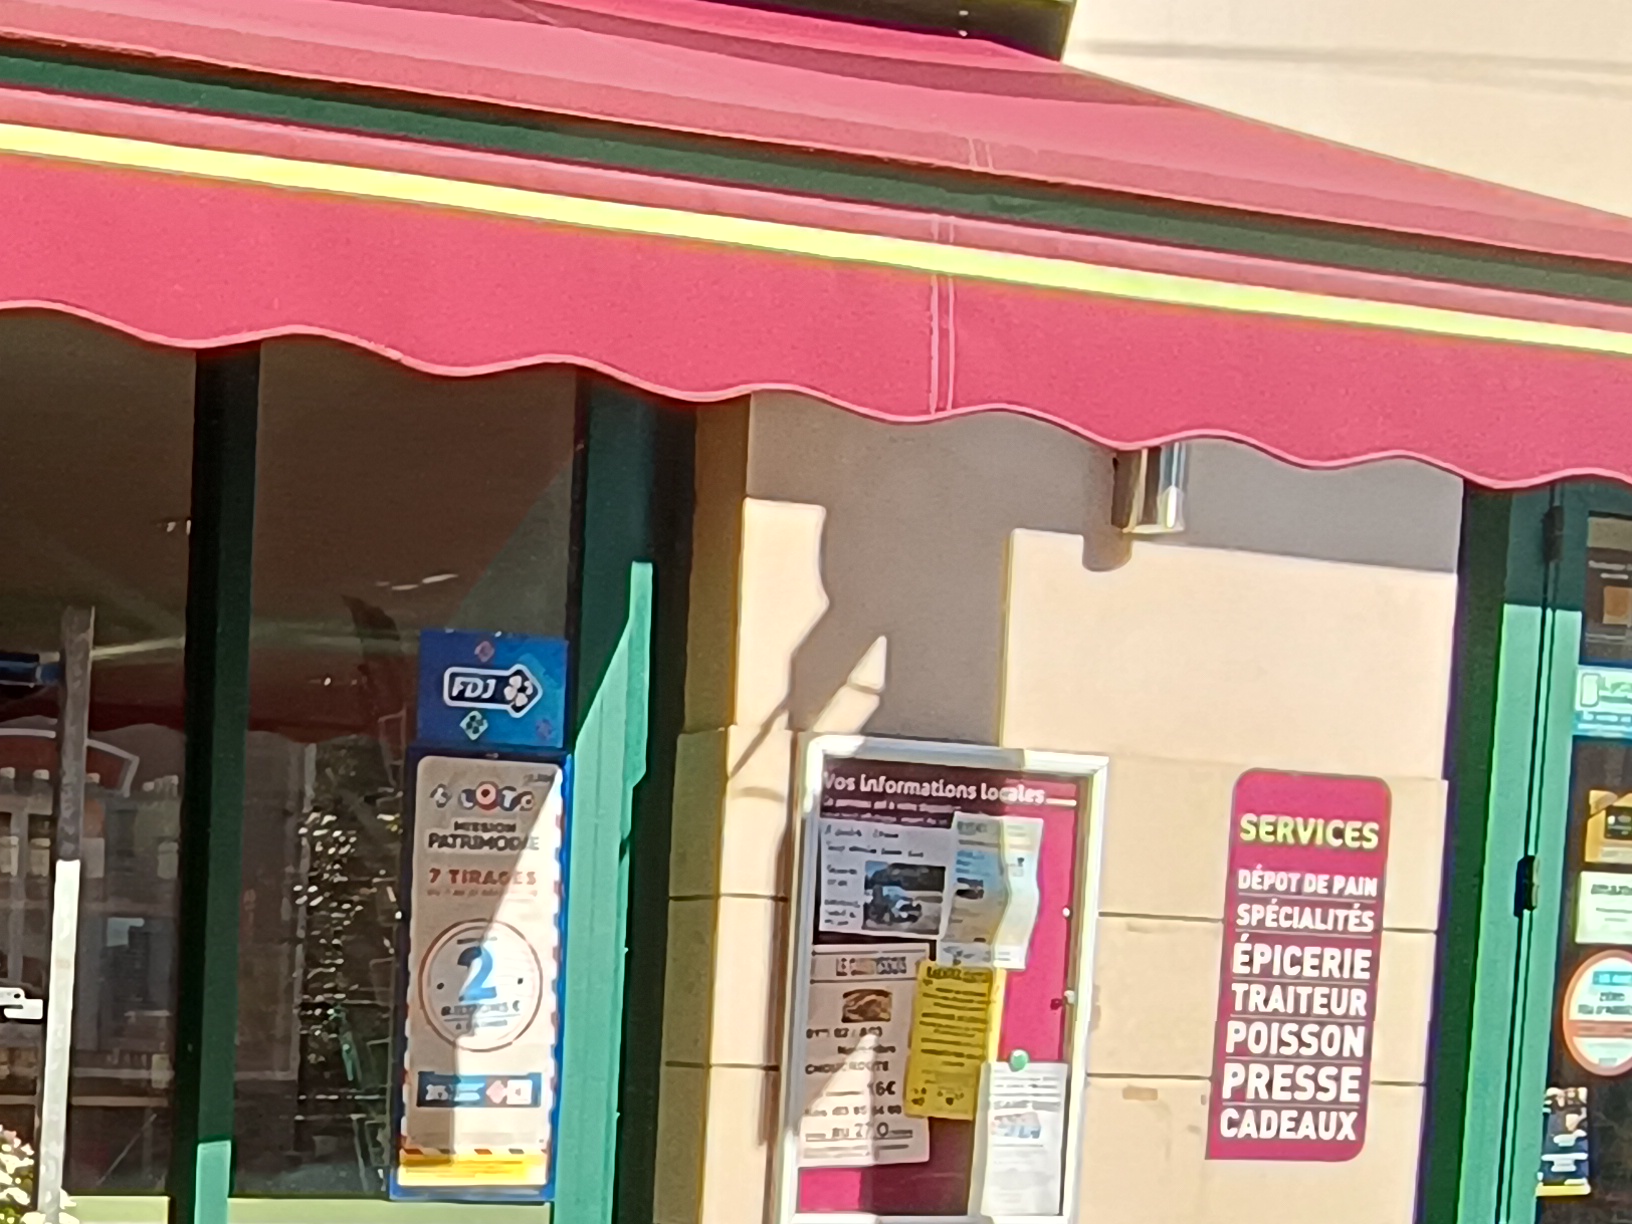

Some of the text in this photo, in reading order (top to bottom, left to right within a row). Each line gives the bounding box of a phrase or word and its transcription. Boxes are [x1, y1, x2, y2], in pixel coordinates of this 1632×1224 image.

[451, 676, 496, 699] FDJ
[823, 771, 856, 791] Vos
[859, 773, 977, 800] informations
[980, 783, 1046, 806] locales
[428, 833, 539, 851] PATRIMOE
[1239, 813, 1380, 849] SERVICES
[429, 868, 441, 883] 7
[1237, 863, 1378, 897] DÉPOT DE PAIN
[1236, 898, 1374, 932] SPÉCIALITÉS
[1232, 933, 1373, 979] ÉPICERIE
[457, 946, 498, 1001] 2
[1231, 983, 1367, 1016] TRAITEUR
[1225, 1020, 1366, 1057] POISSON
[1222, 1062, 1362, 1102] PRESSE
[1220, 1108, 1358, 1141] CADEAUX
